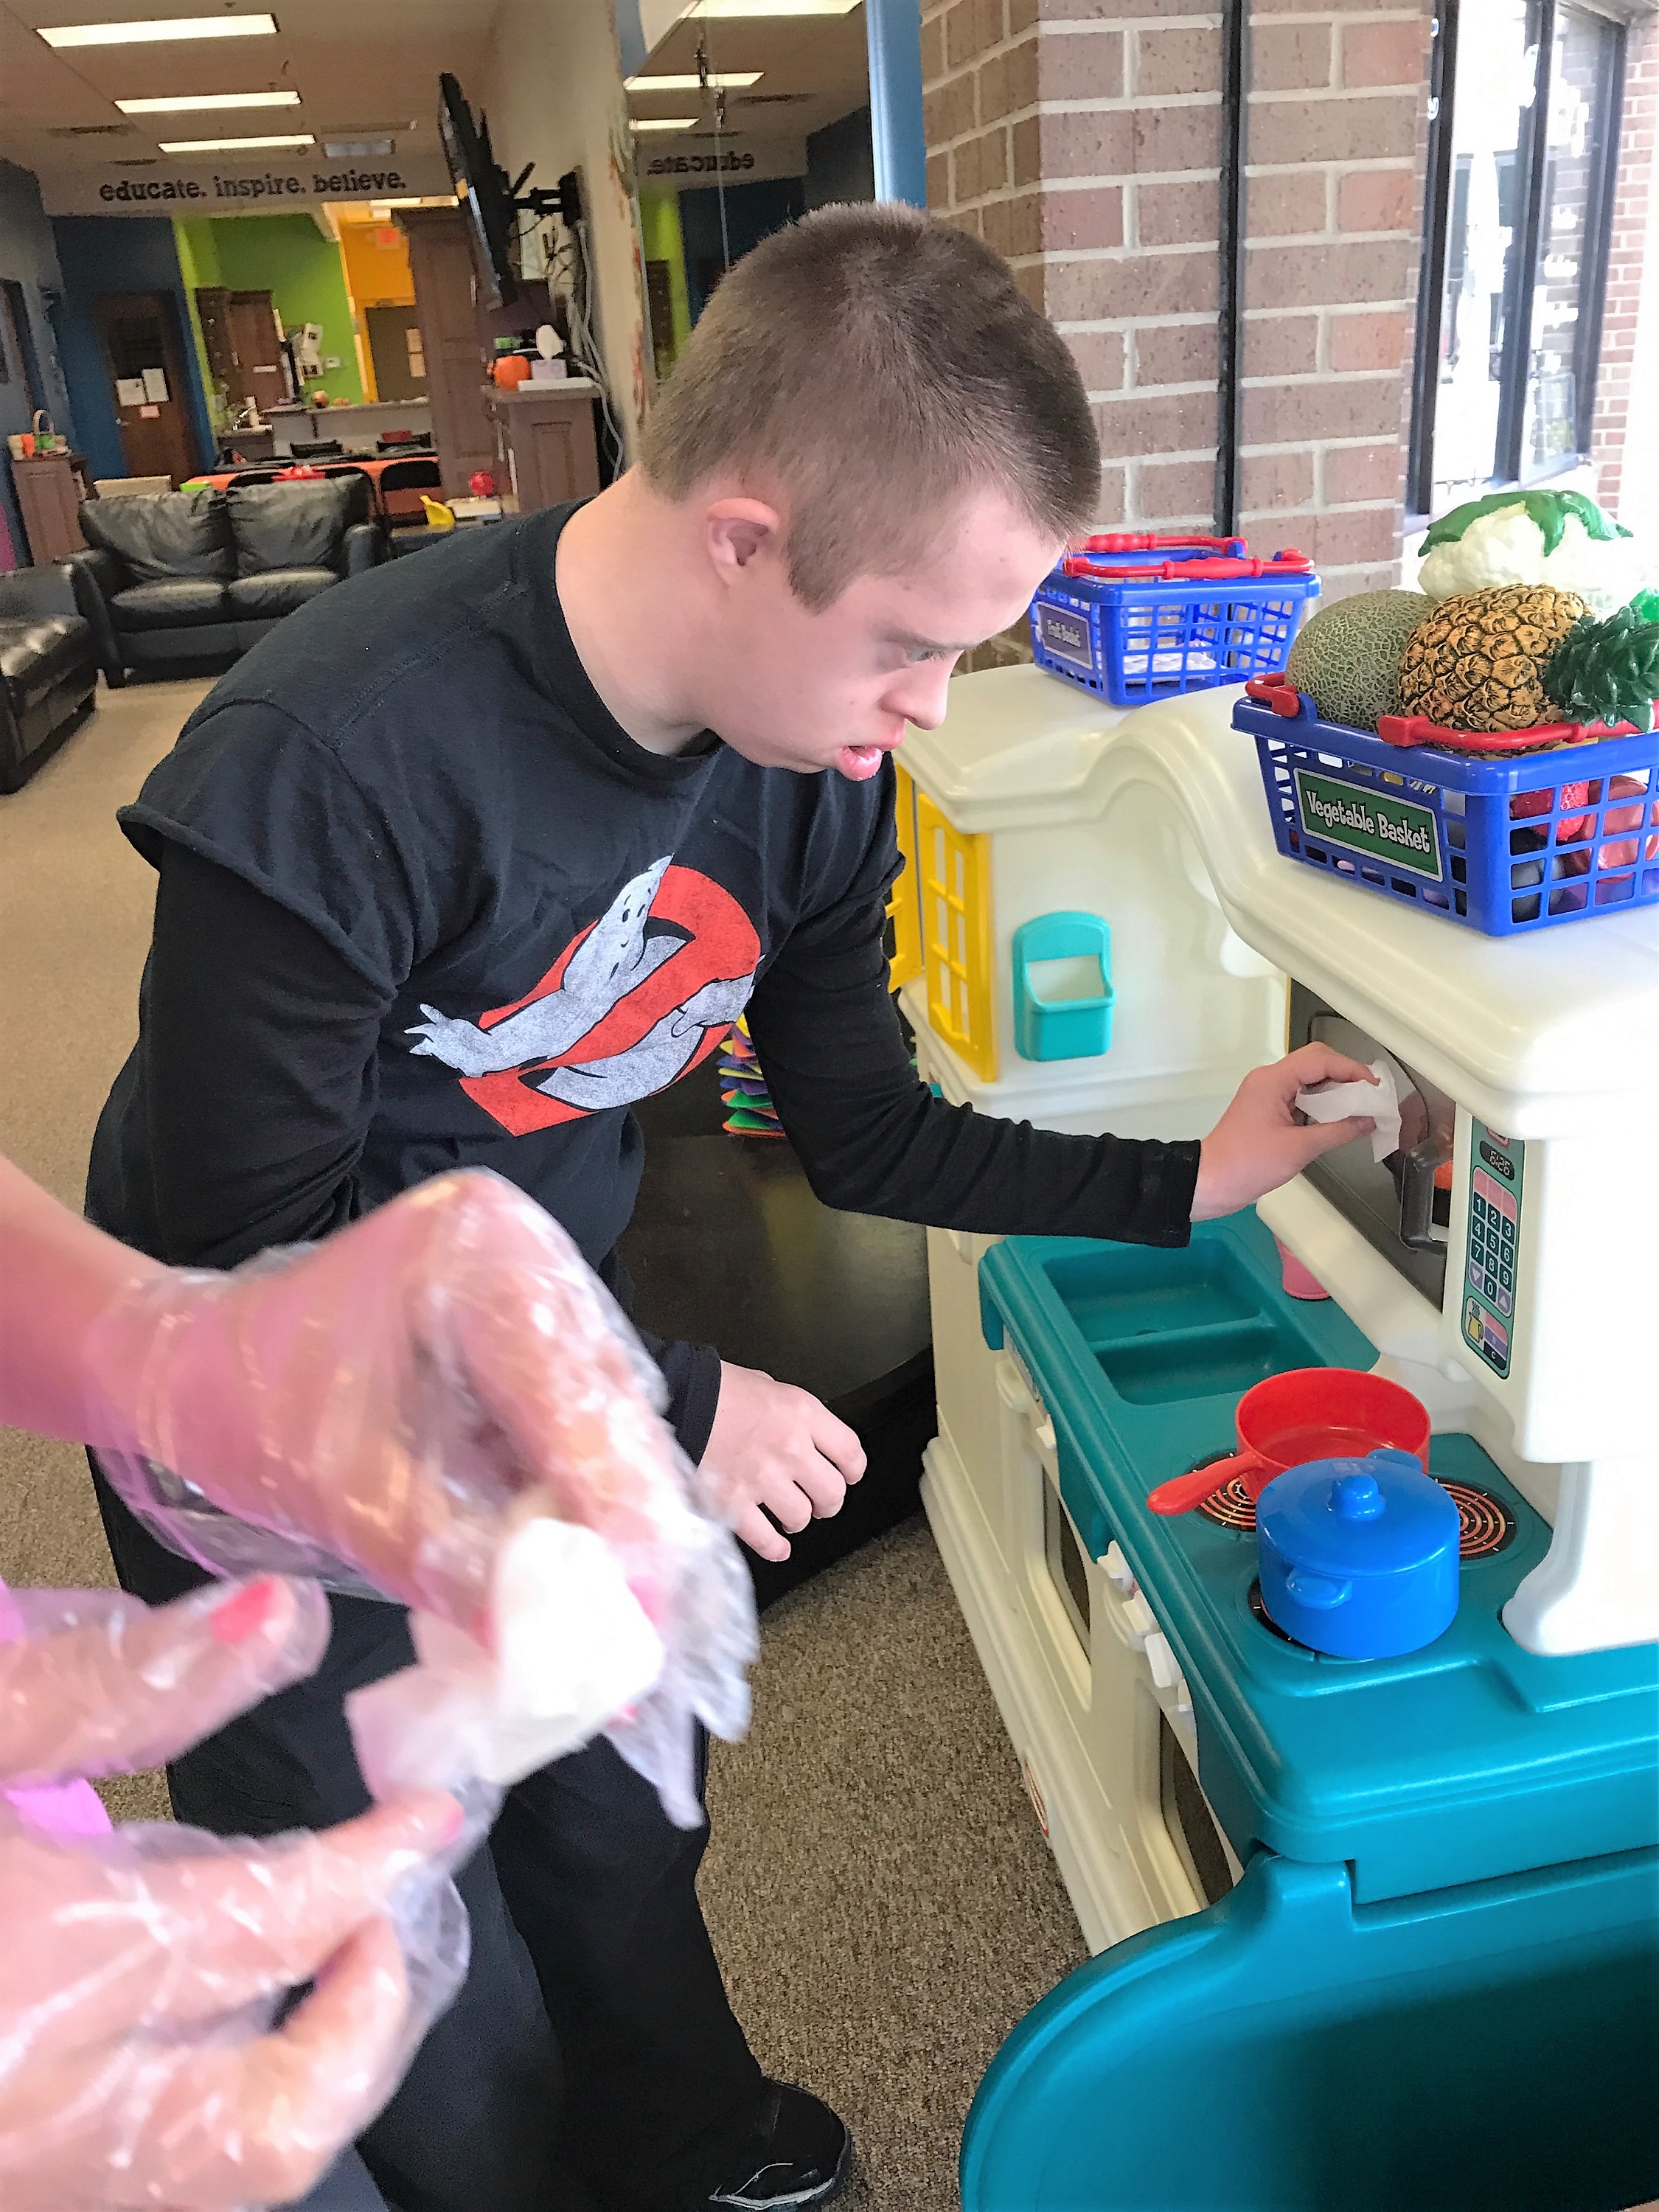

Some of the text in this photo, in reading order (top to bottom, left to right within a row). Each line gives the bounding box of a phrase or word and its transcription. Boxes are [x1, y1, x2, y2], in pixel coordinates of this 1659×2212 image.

[99, 169, 406, 201] educate. inspire. believe.
[1306, 790, 1430, 854] Vegetable Basket
[1476, 1198, 1512, 1237] 1 2 3
[1475, 1222, 1510, 1262] 4 5 6
[1475, 1244, 1509, 1286] 7 8 9
[1487, 1281, 1493, 1296] 0
